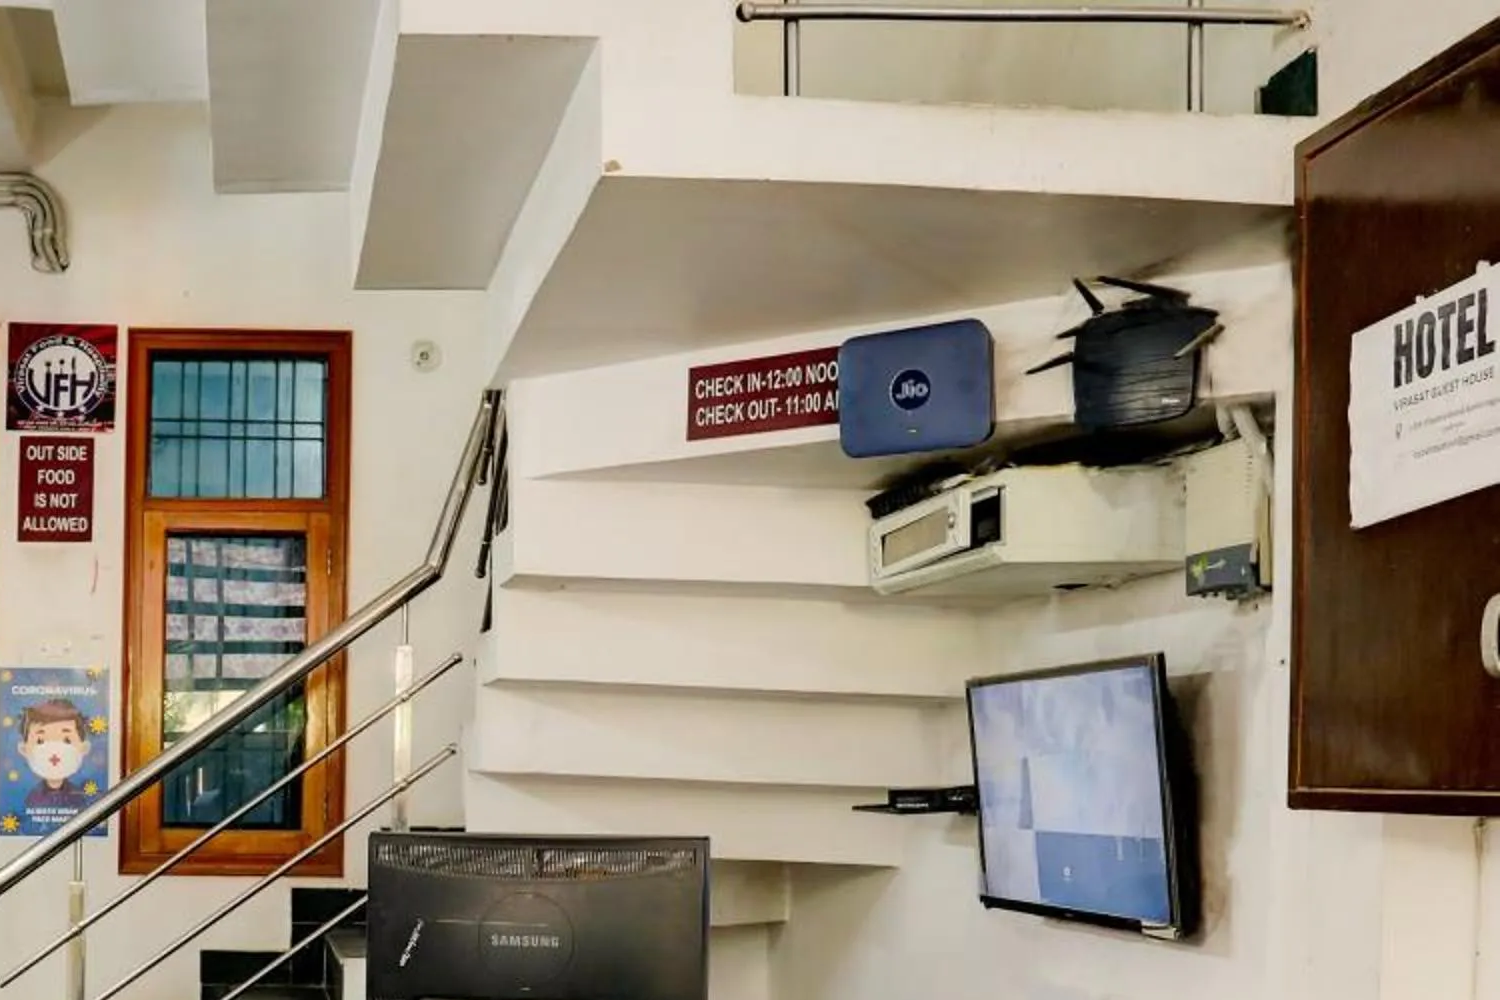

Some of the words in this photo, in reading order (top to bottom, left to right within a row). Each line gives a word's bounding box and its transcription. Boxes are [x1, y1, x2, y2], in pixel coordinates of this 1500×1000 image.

[1393, 287, 1496, 390] HOTEL
[695, 374, 745, 399] CHECK
[747, 367, 803, 393] IN-12:00
[805, 361, 839, 385] NOO
[1461, 365, 1495, 386] HOUSE
[895, 379, 929, 399] Jio
[695, 402, 745, 427] CHECK
[747, 397, 782, 421] OUT-
[785, 391, 821, 415] 11:00
[26, 446, 53, 461] OUT
[57, 446, 87, 461] SIDE
[37, 470, 75, 485] FOOD
[34, 493, 47, 508] IS
[50, 493, 78, 508] NOT
[23, 517, 88, 532] ALLOWED
[11, 685, 98, 696] CORONAVIRUS
[491, 933, 560, 949] SAMSUNG
